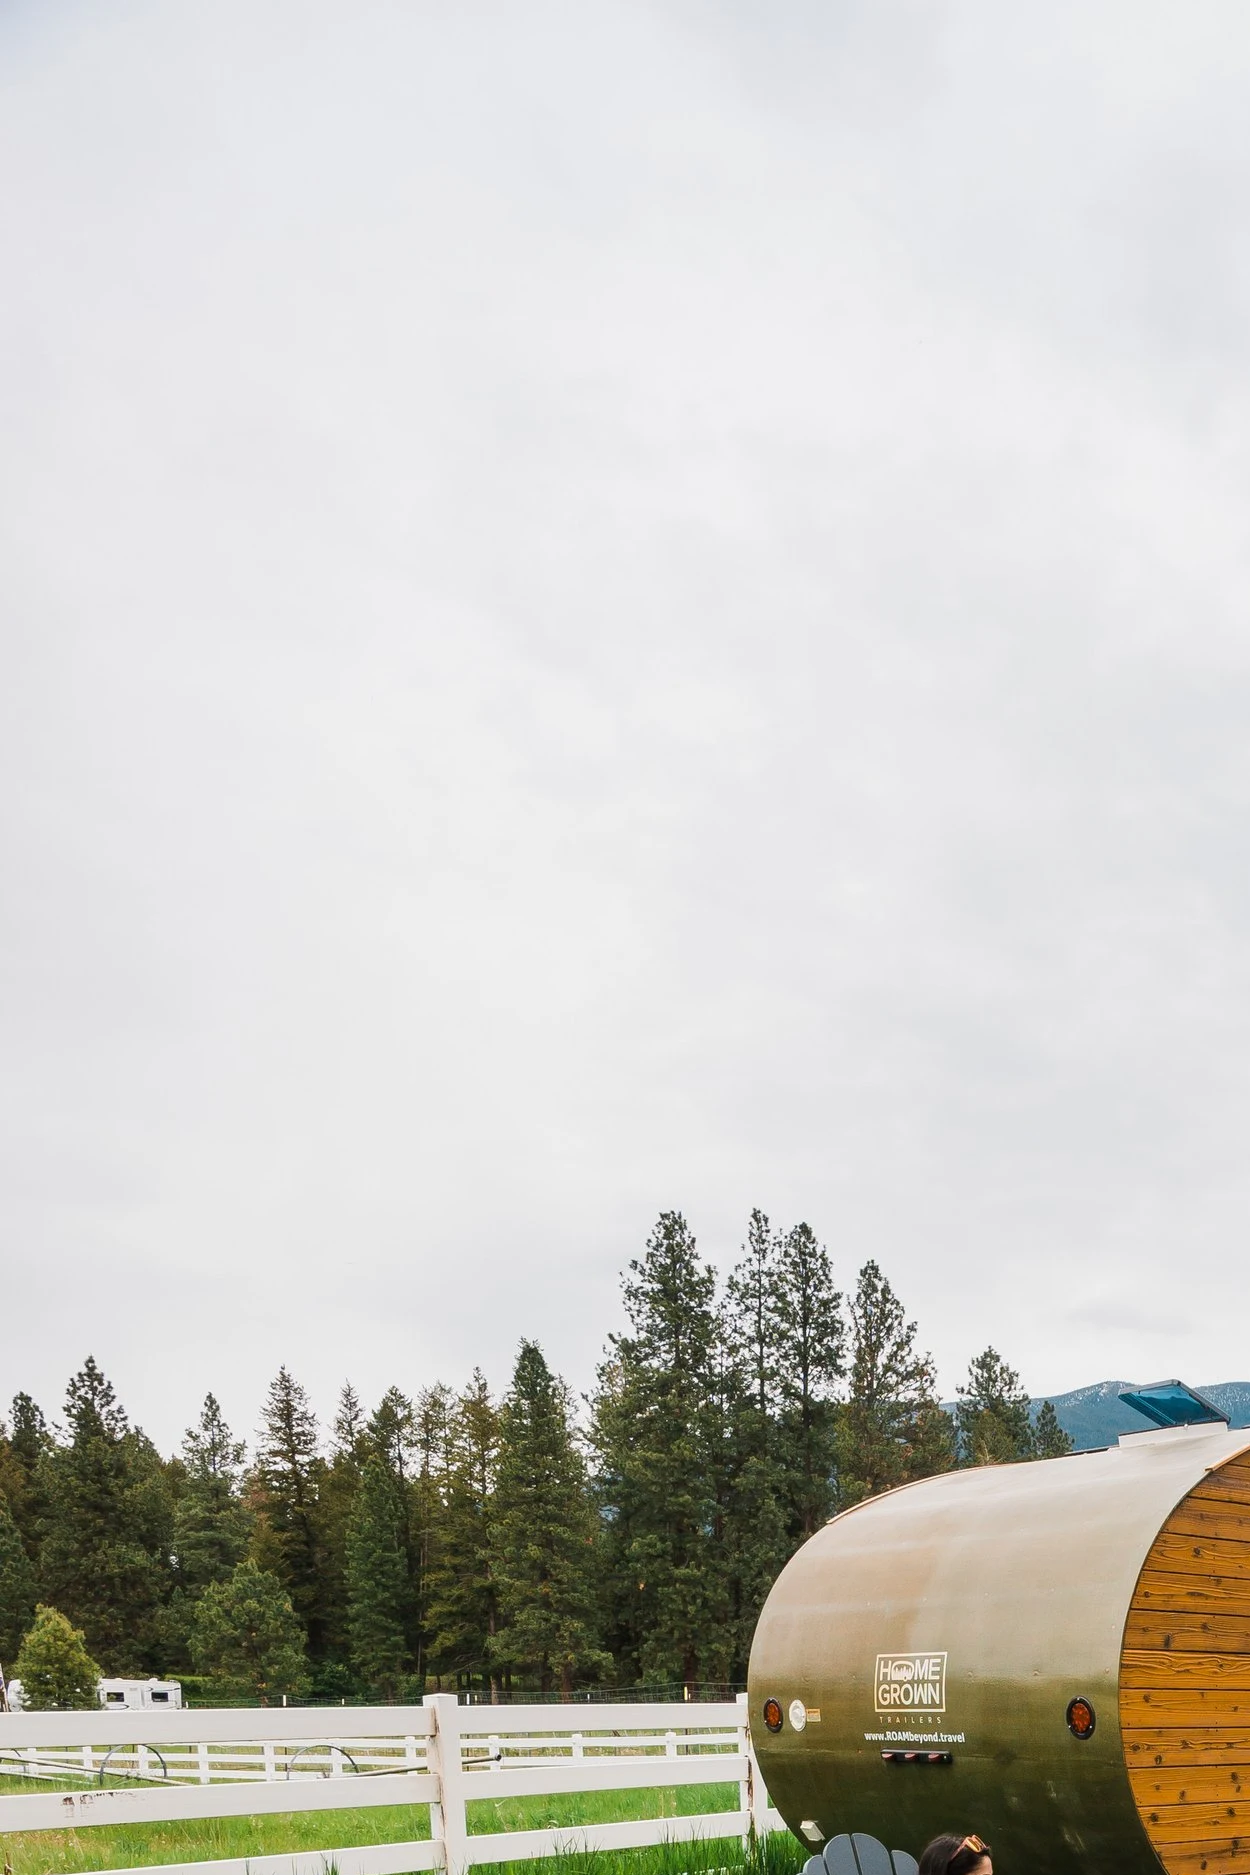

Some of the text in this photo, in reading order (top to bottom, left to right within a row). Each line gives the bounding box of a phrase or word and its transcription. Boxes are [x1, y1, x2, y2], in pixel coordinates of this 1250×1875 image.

[878, 1683, 940, 1705] GROWN
[880, 1716, 942, 1724] TRAILERS
[864, 1731, 966, 1744] www.ROAMbeyond.travel
